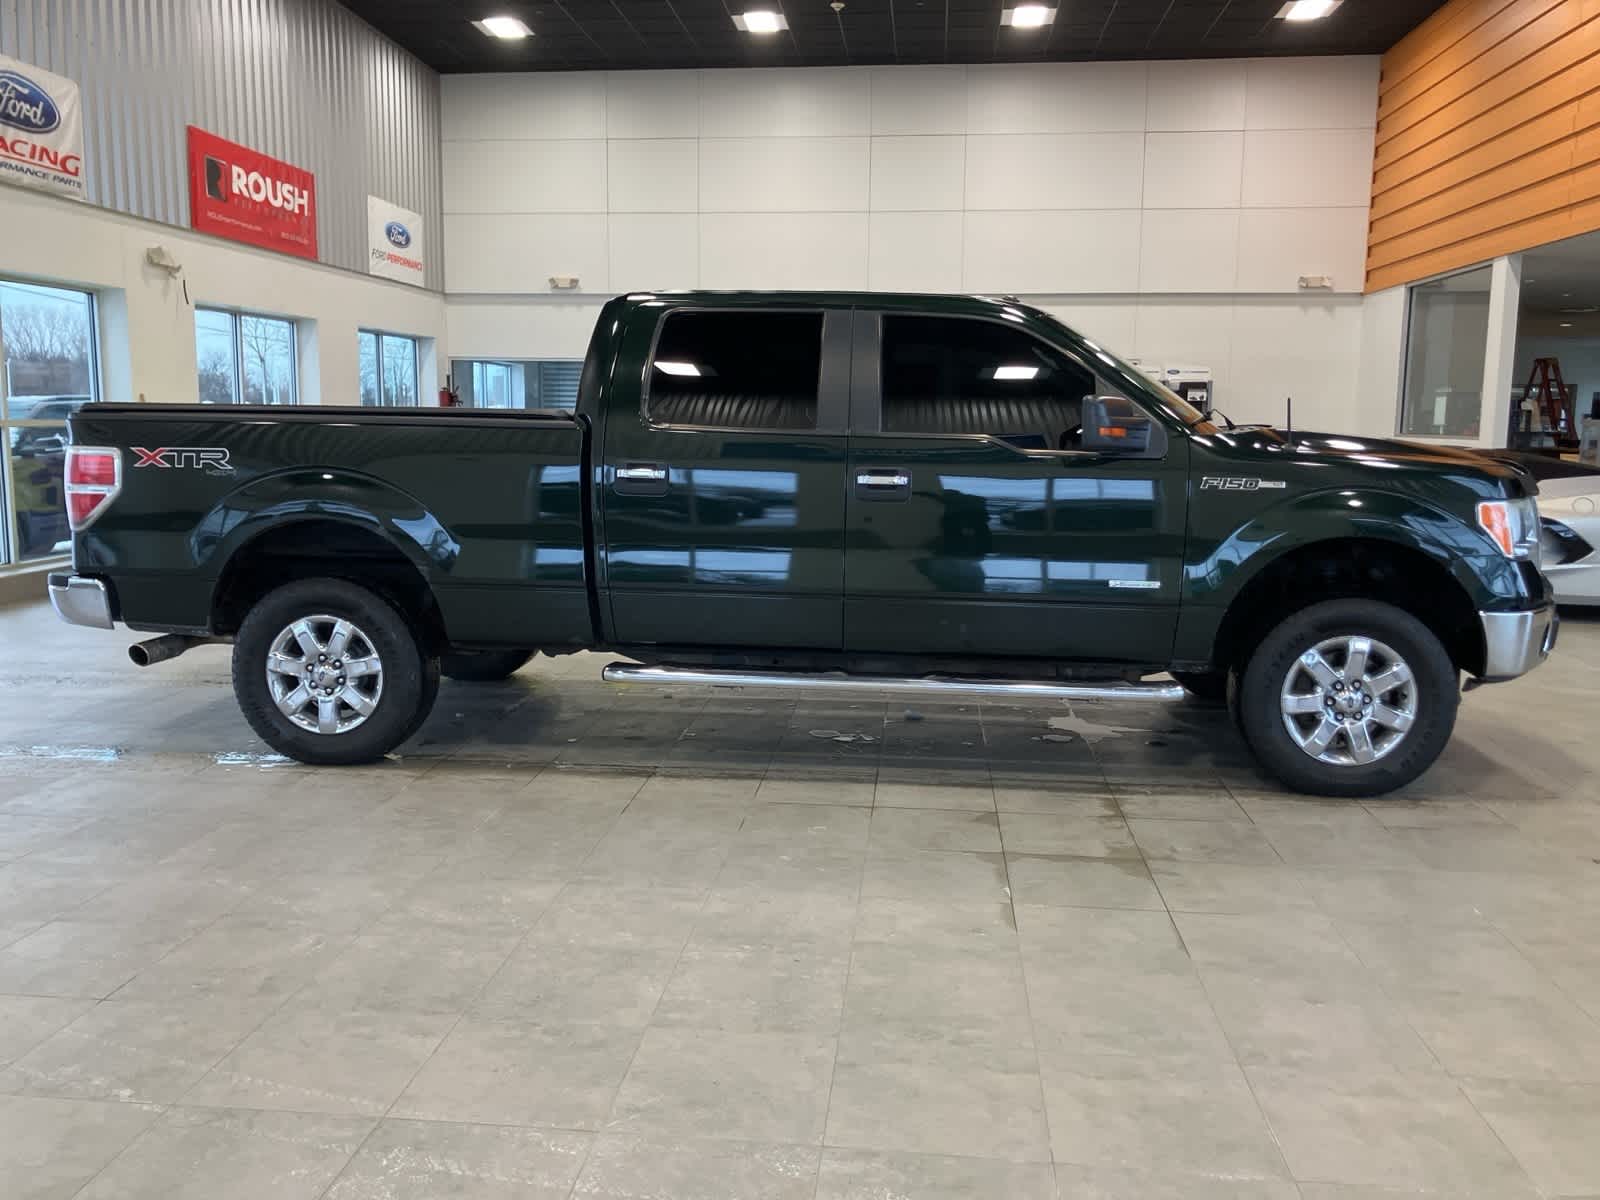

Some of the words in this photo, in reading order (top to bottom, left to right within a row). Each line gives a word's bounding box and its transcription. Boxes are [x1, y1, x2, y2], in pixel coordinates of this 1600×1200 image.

[231, 164, 308, 216] ROUSH
[390, 224, 407, 245] Ford
[129, 447, 234, 469] XTR
